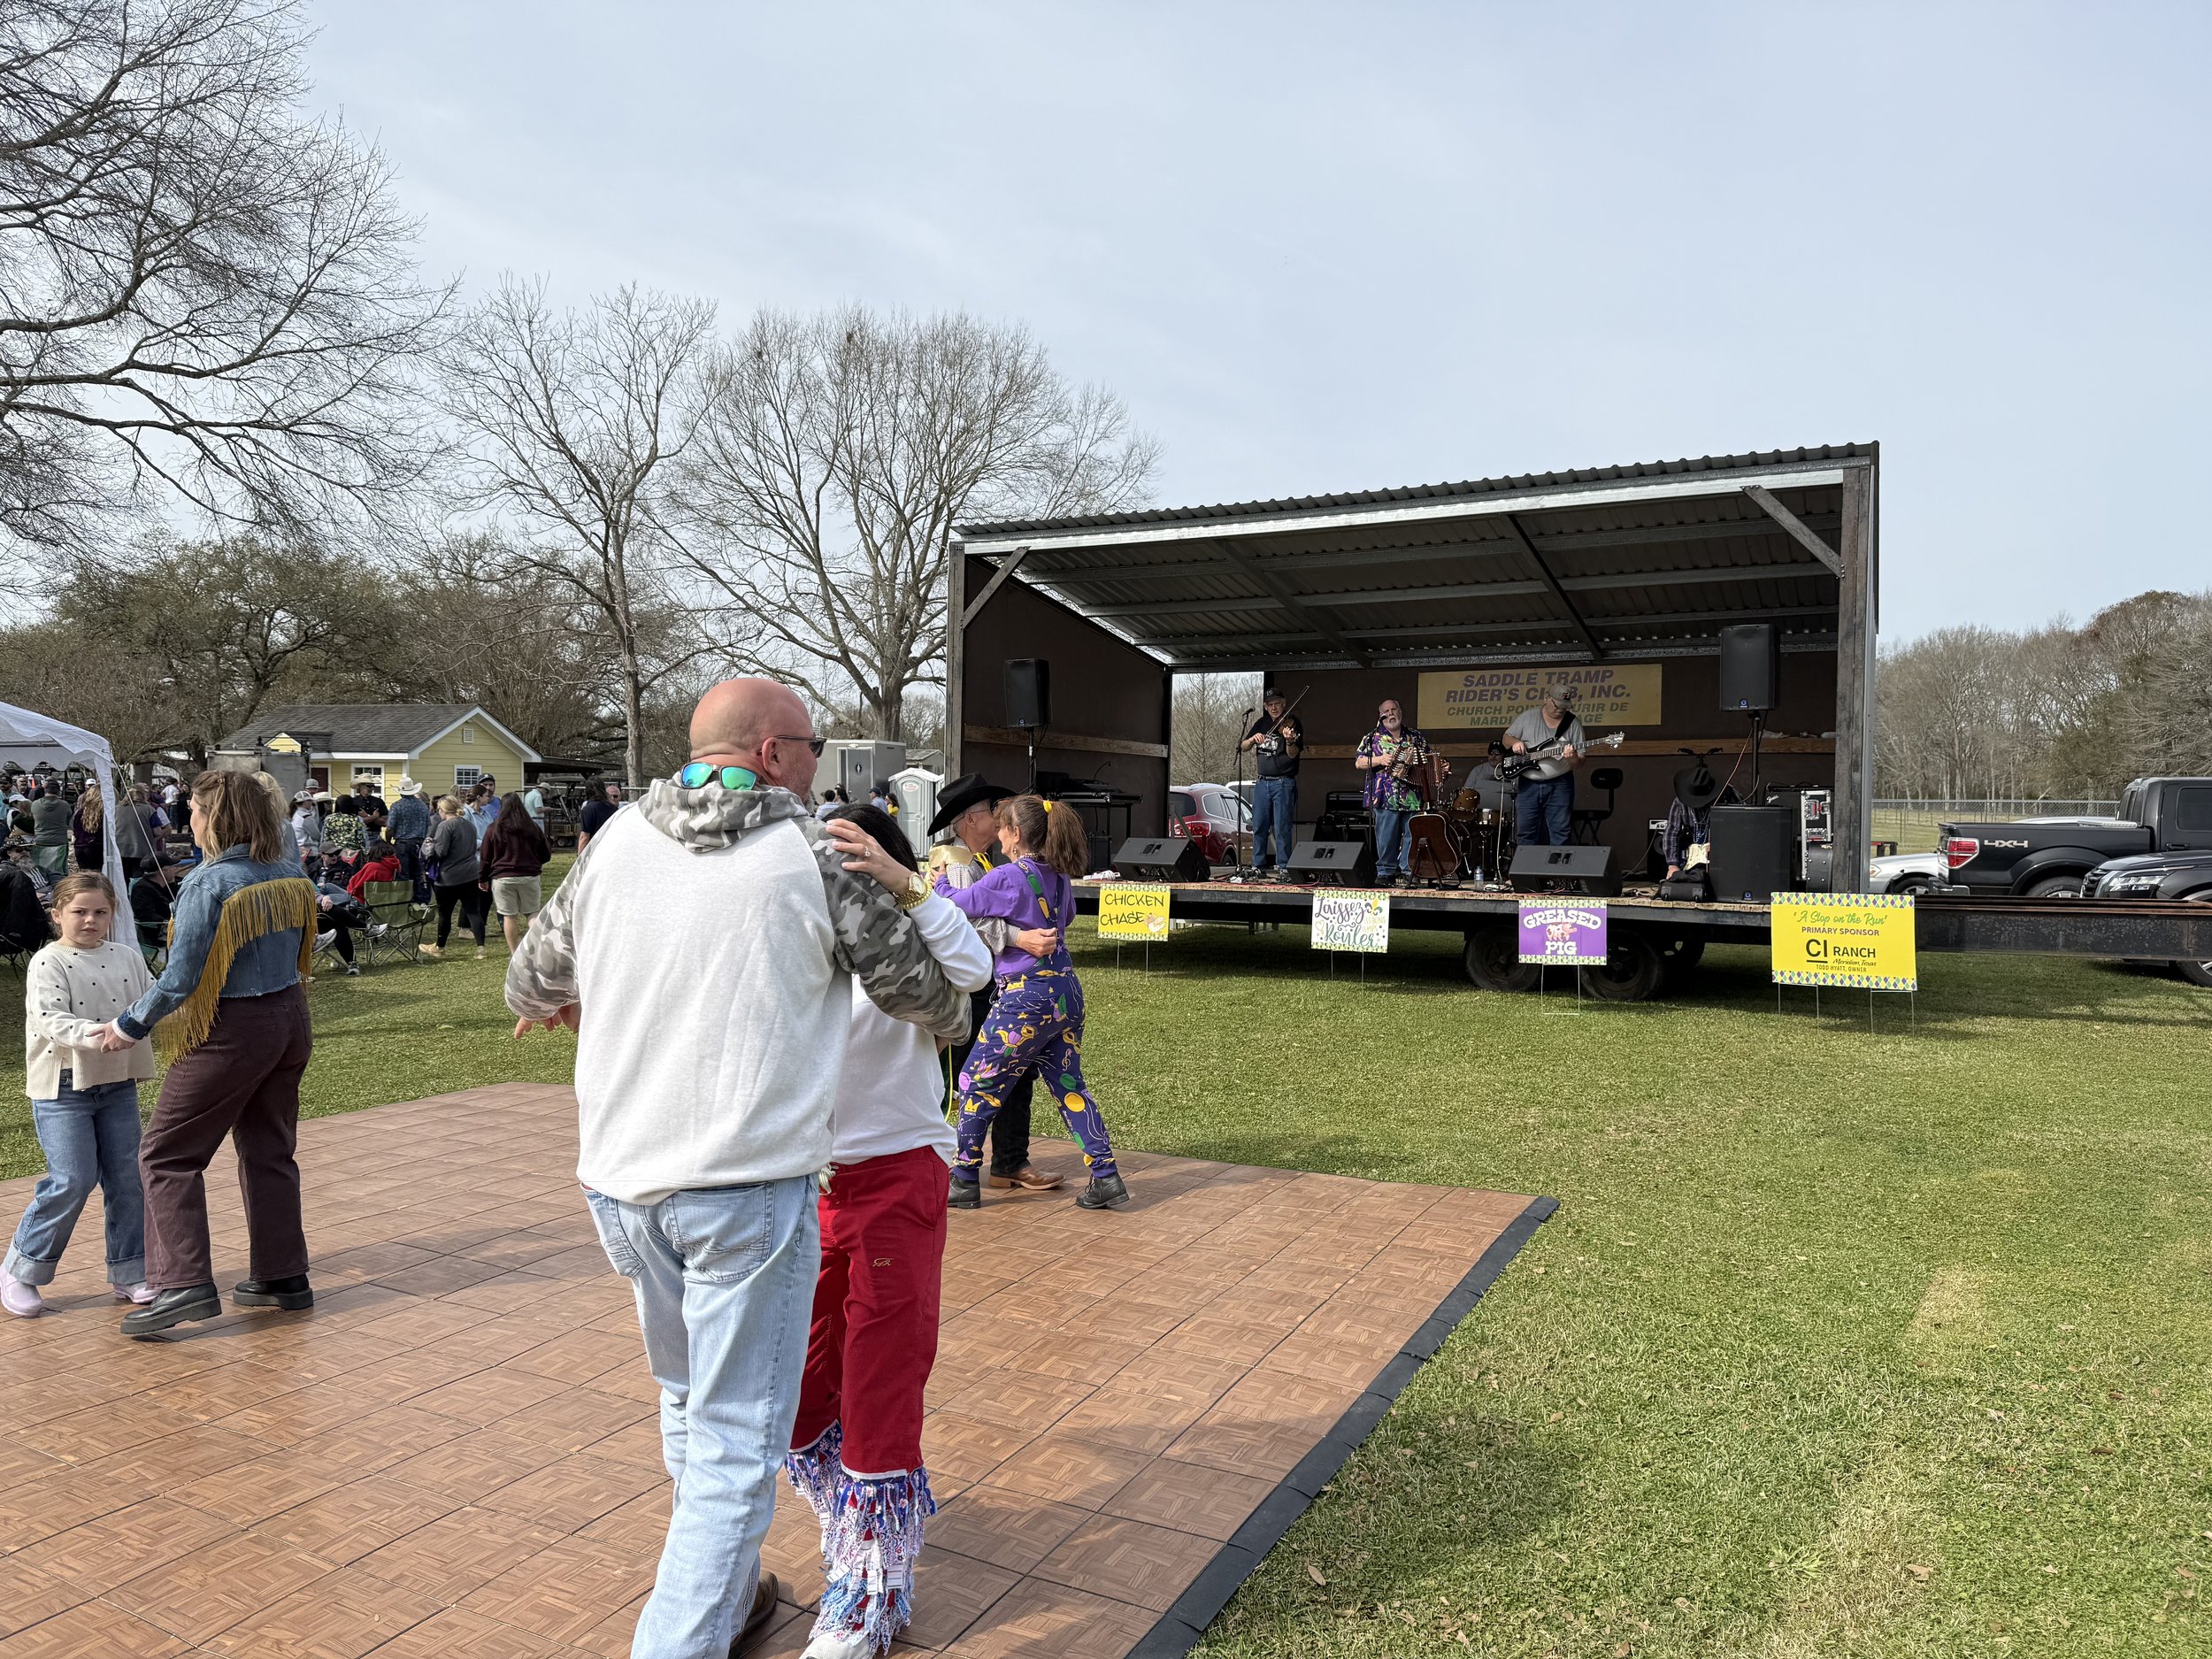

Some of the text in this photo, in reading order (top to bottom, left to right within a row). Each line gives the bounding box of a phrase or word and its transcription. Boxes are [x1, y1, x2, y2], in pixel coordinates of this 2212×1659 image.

[1463, 670, 1614, 687] SADDLE TRAMP
[1446, 685, 1630, 703] RIDER'S CLB, INC.
[1448, 706, 1502, 716] CHURCH
[1610, 703, 1629, 711] DE
[1471, 716, 1513, 726] MARDI
[1105, 893, 1164, 907] CHICKEN
[1315, 896, 1364, 924] Laissez
[1100, 911, 1144, 926] CHASE
[1523, 909, 1601, 930] GREASED
[1846, 912, 1862, 924] the
[1839, 927, 1880, 936] SPONSOR
[1545, 941, 1577, 955] PIG
[1806, 938, 1876, 958] CI RANCH
